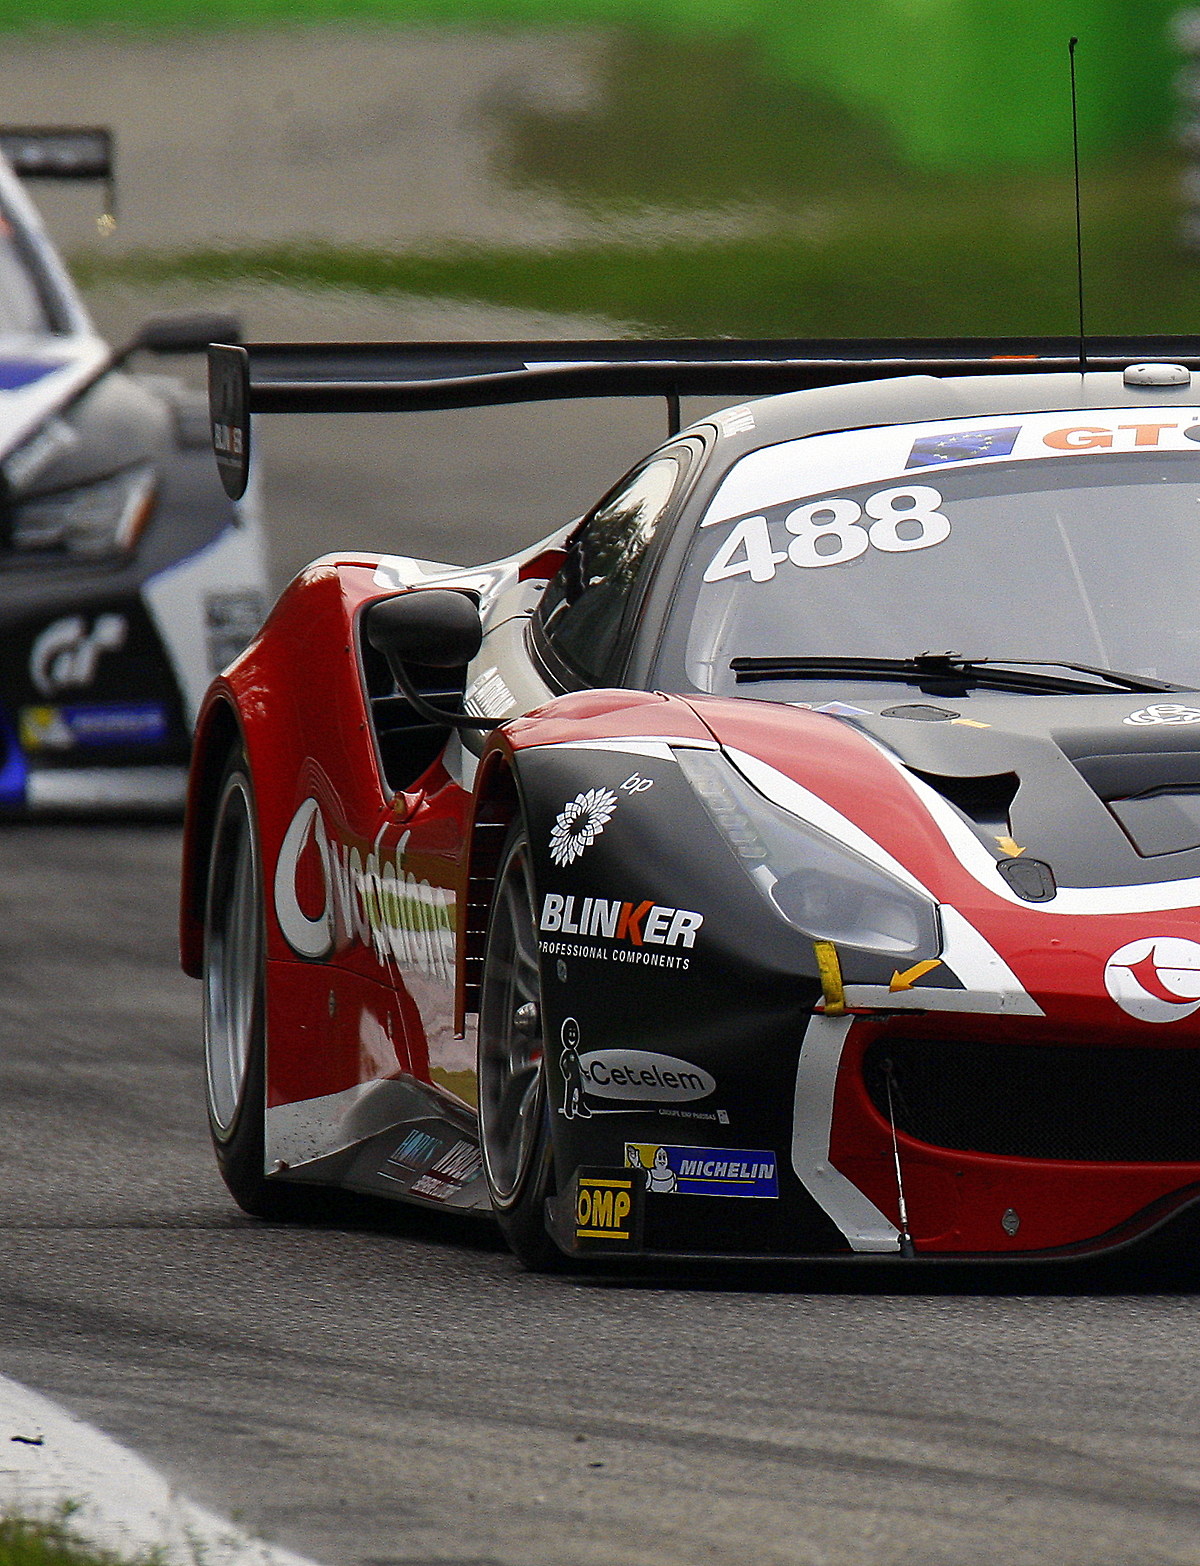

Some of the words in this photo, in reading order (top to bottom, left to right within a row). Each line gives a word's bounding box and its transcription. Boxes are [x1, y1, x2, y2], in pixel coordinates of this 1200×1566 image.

[703, 485, 952, 583] 488
[619, 771, 655, 796] bp
[539, 892, 705, 949] BLINKER
[612, 948, 691, 971] COMPONENTS
[589, 1060, 706, 1091] Cetelem
[679, 1159, 775, 1180] MICHELIN
[577, 1189, 632, 1228] OMP
